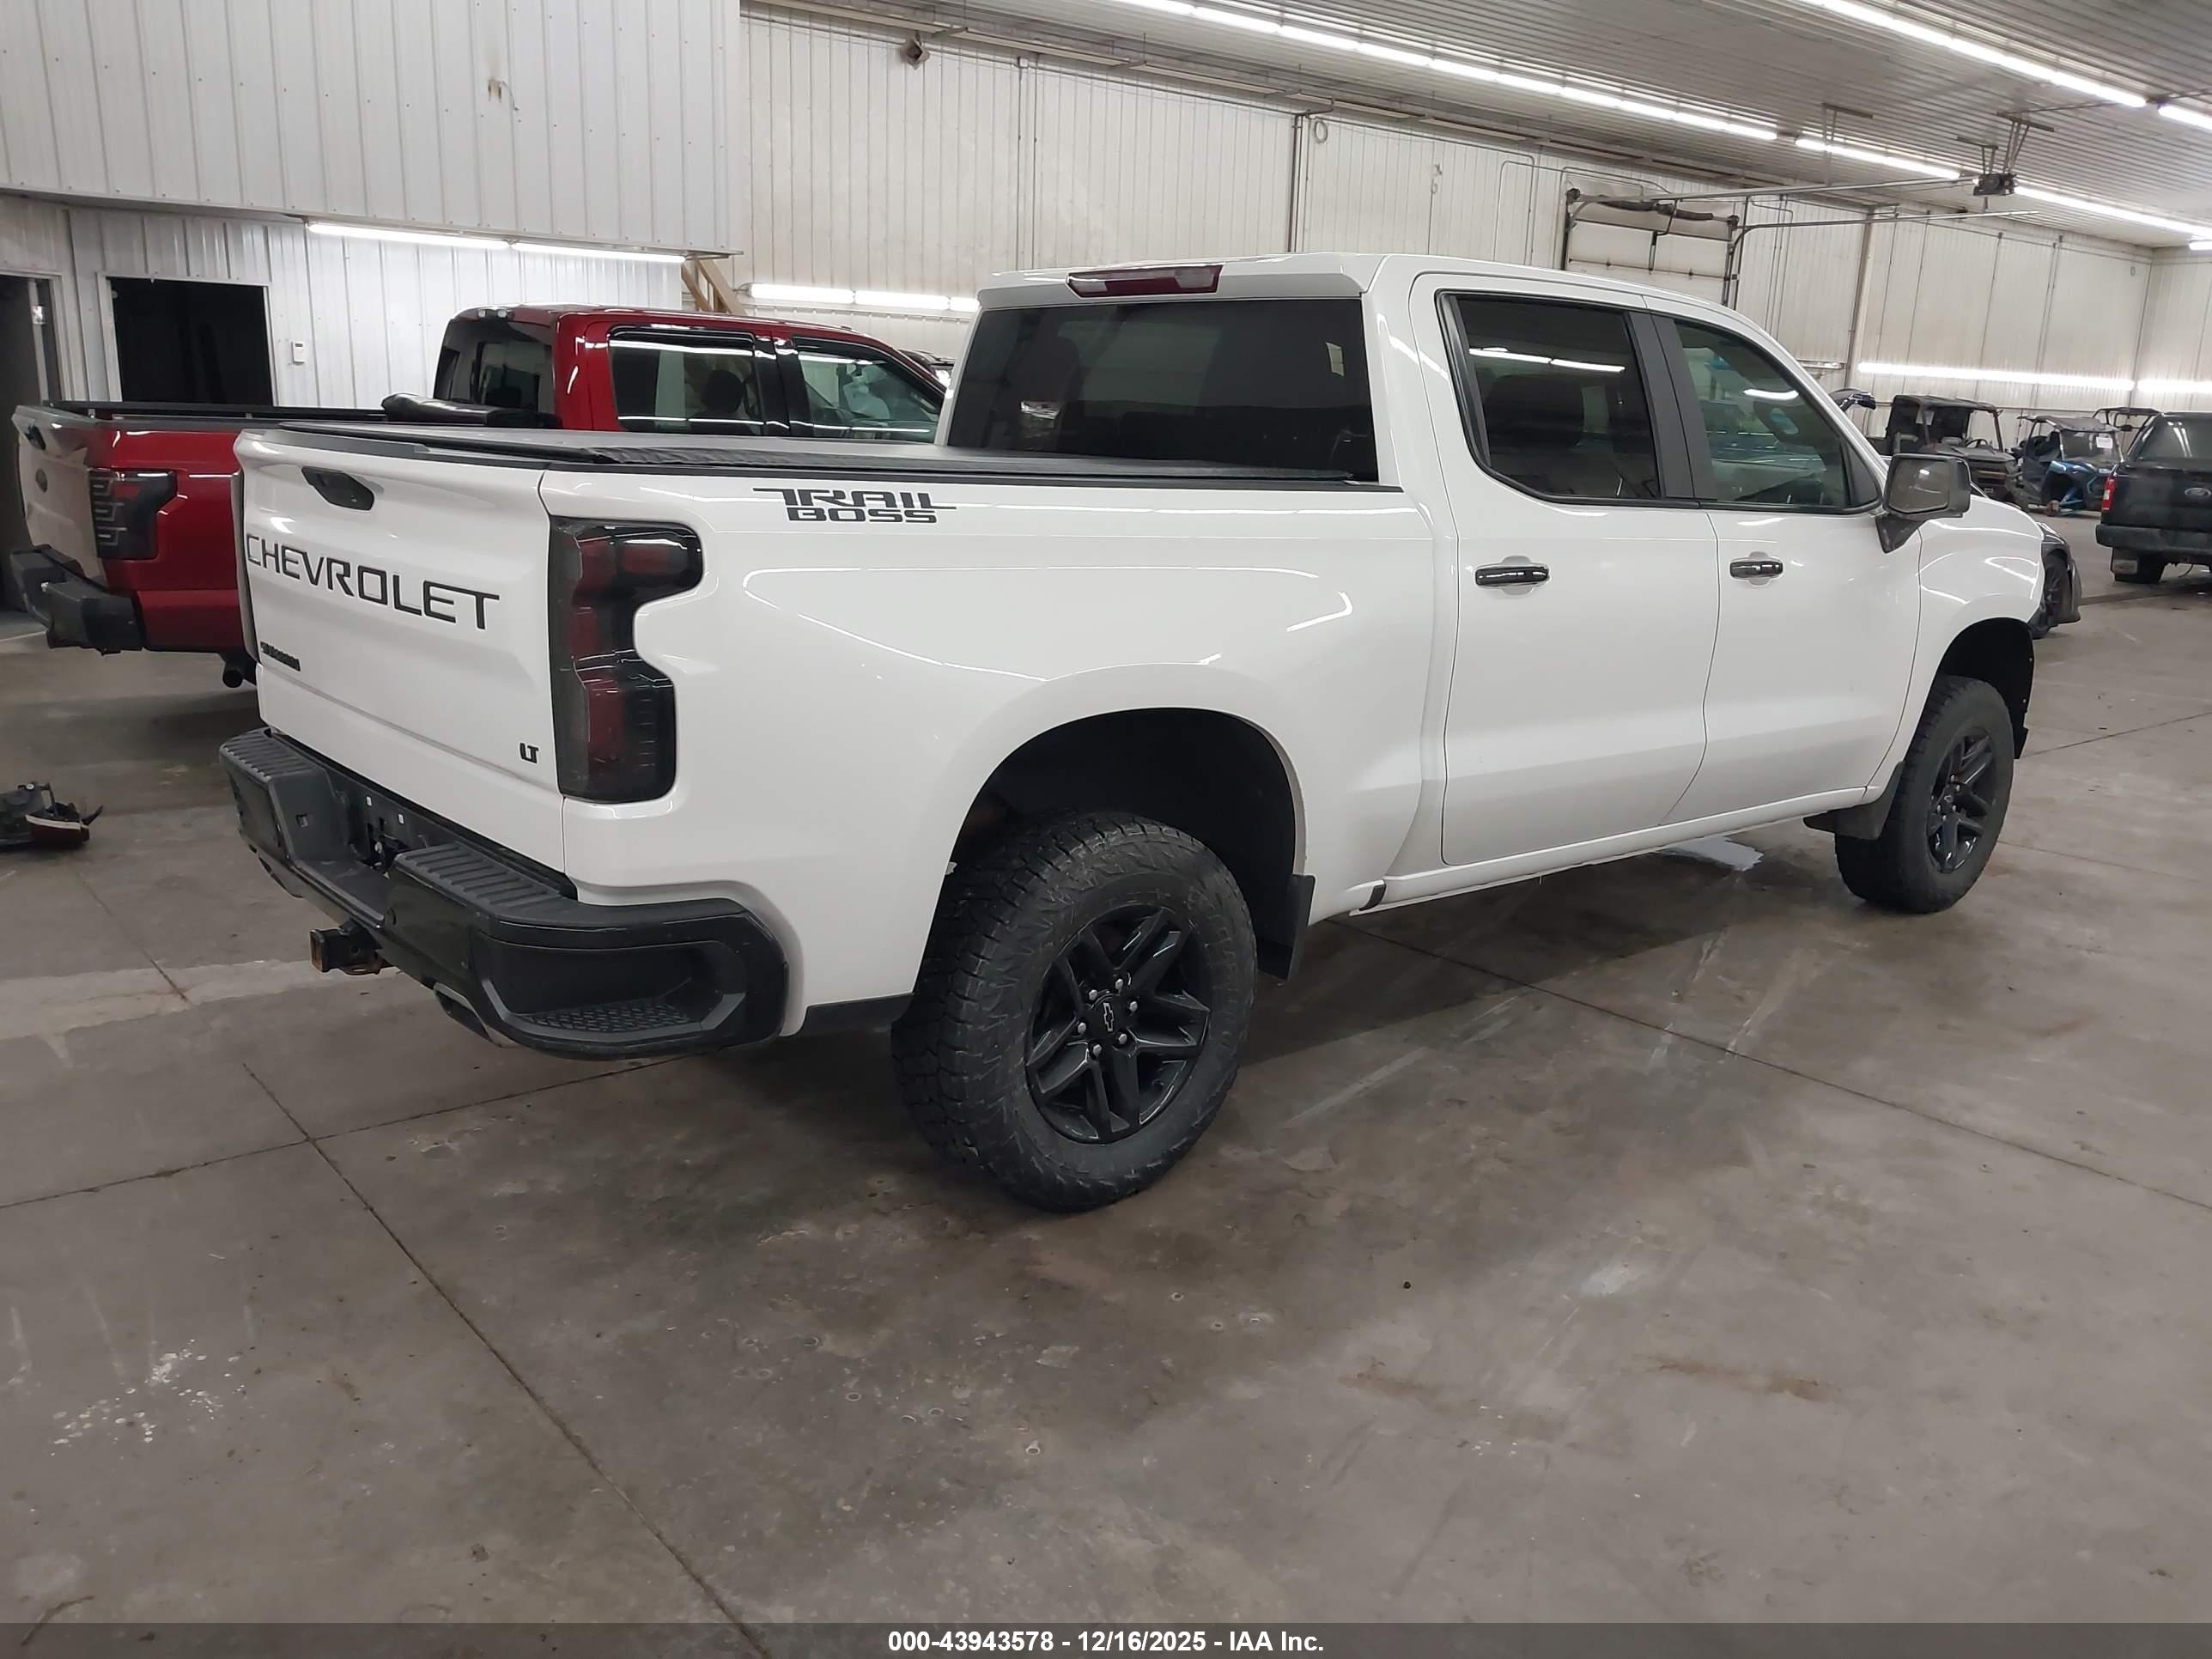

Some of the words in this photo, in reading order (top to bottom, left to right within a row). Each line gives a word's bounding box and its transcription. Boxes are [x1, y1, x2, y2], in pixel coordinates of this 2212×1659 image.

[752, 487, 957, 510] TRAIL
[786, 507, 938, 524] BOSS
[246, 533, 500, 630] CHEVROLET
[519, 742, 539, 764] LT
